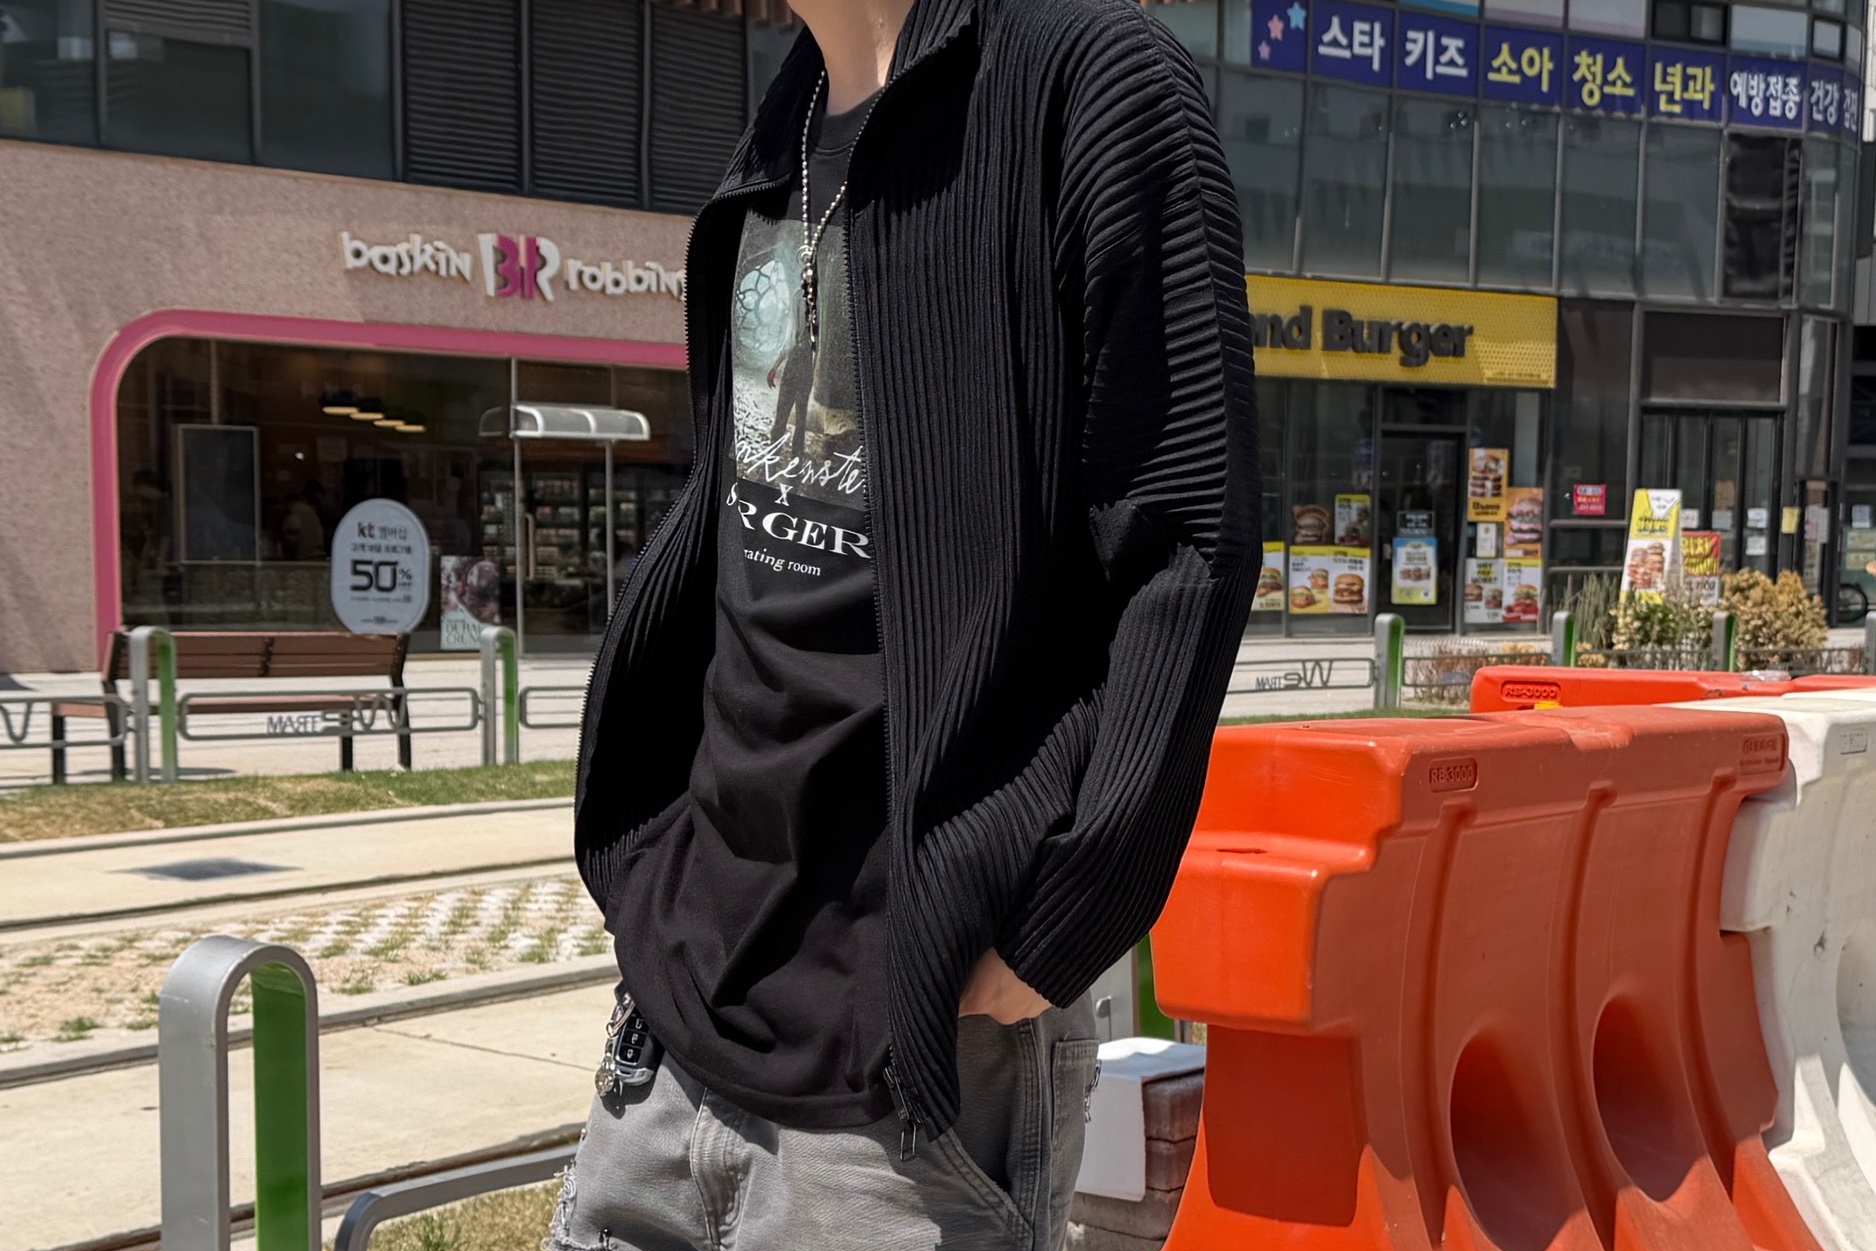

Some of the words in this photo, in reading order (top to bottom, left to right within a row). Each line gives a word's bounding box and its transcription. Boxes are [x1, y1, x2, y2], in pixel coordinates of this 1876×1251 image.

[339, 230, 473, 283] baskin
[1247, 304, 1313, 351] nd
[1321, 307, 1475, 368] Burger
[357, 521, 375, 539] kt
[787, 560, 822, 577] room
[1430, 766, 1474, 785] RB-3000
